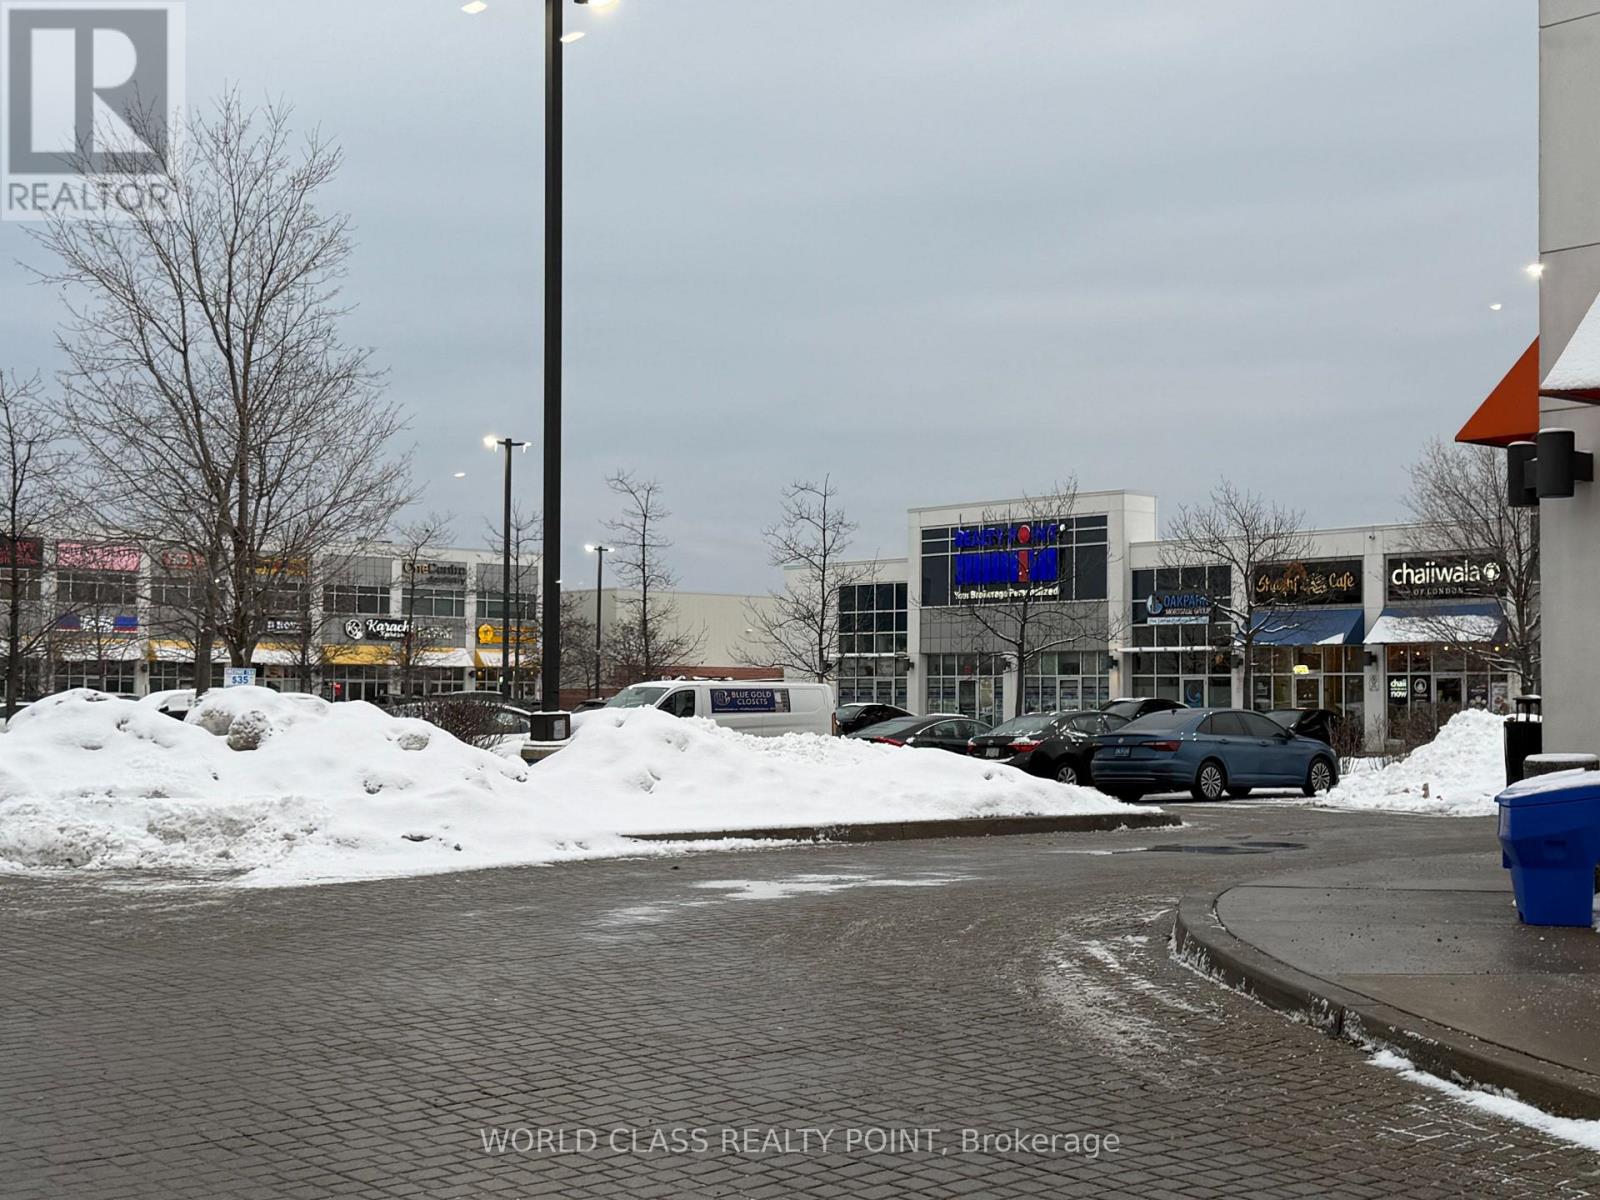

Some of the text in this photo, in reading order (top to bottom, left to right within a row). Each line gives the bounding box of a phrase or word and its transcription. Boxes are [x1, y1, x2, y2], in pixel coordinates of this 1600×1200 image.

[1391, 559, 1481, 586] chaiiwala
[1413, 586, 1464, 596] OF LONDON
